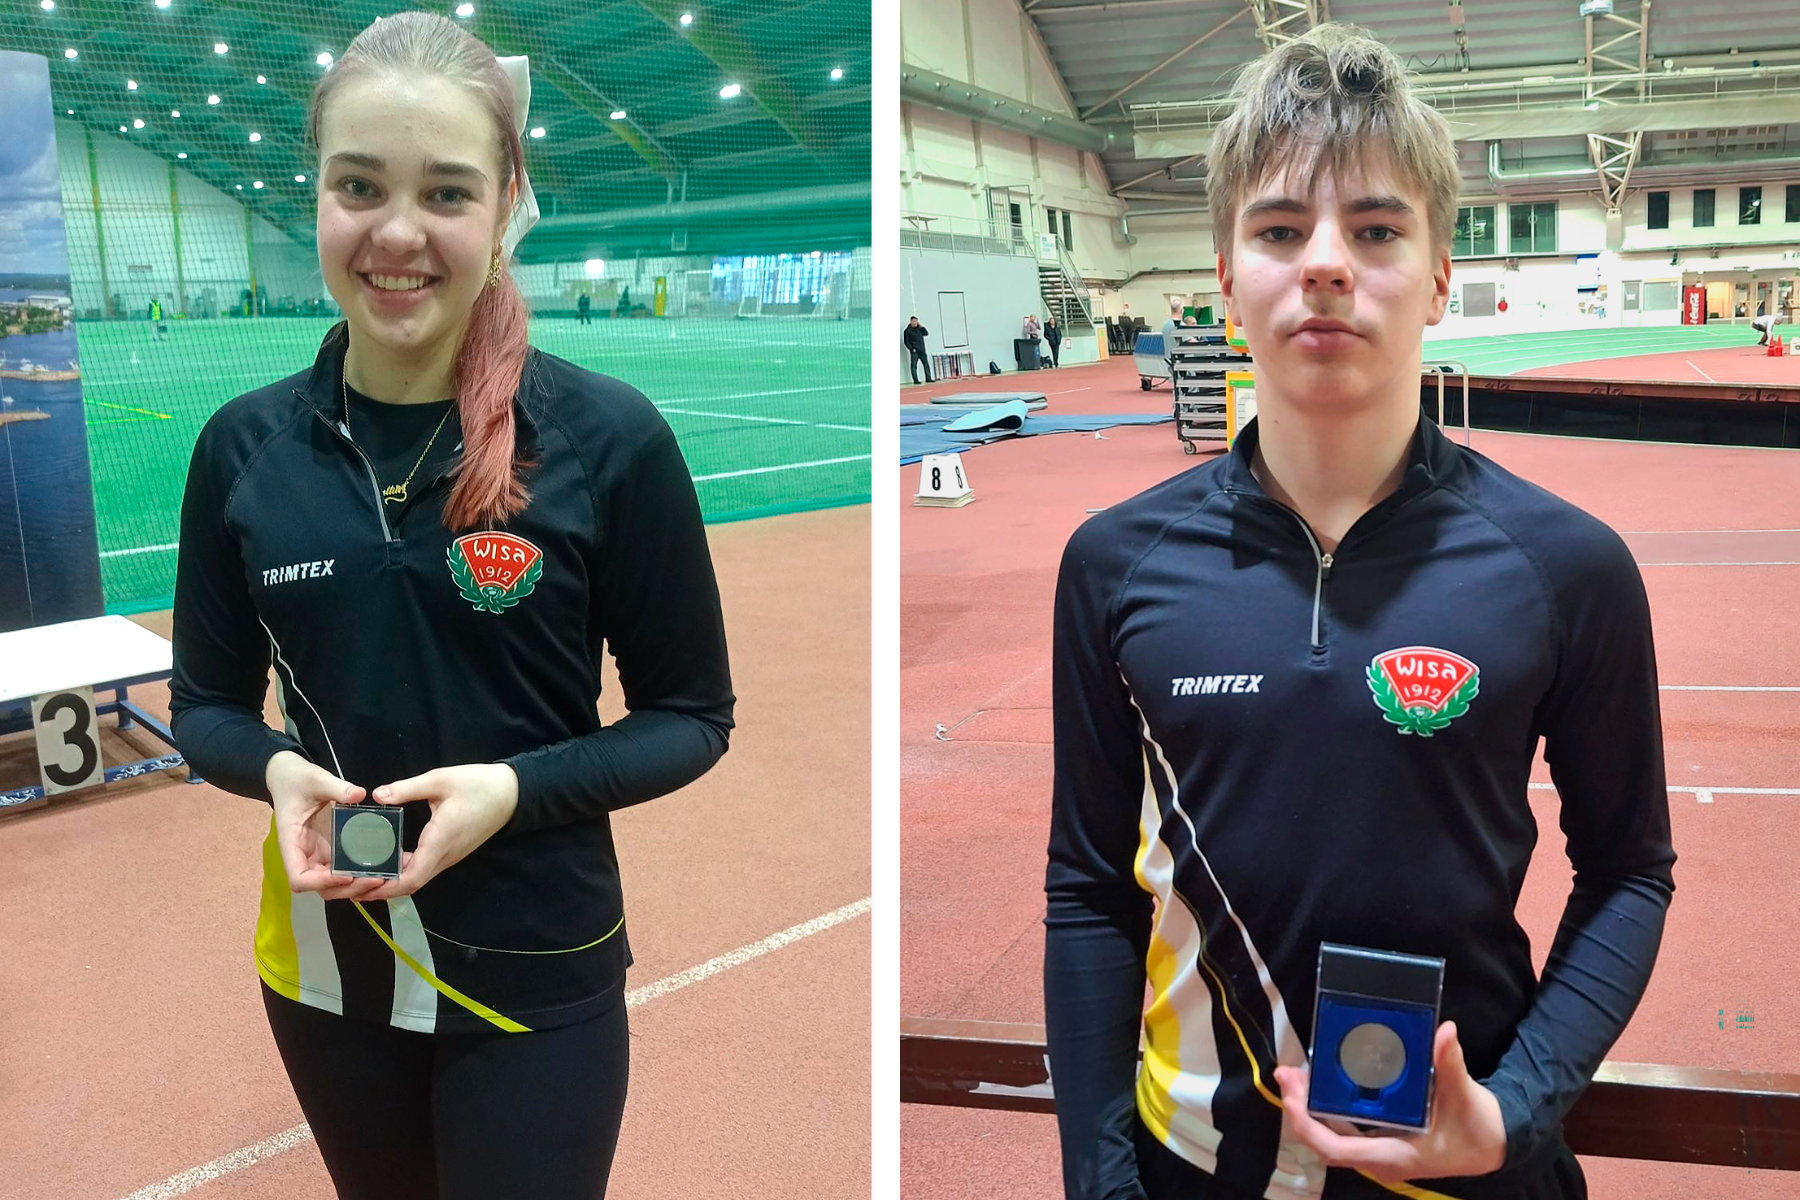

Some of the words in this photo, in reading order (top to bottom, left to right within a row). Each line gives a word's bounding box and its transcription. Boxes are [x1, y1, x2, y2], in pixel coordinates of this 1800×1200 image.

[932, 467, 941, 491] 8
[262, 559, 335, 586] TRIMTEX
[479, 565, 512, 583] 1912
[1171, 674, 1264, 697] TRIMTEX
[1404, 684, 1442, 701] 1912
[40, 693, 98, 787] 3
